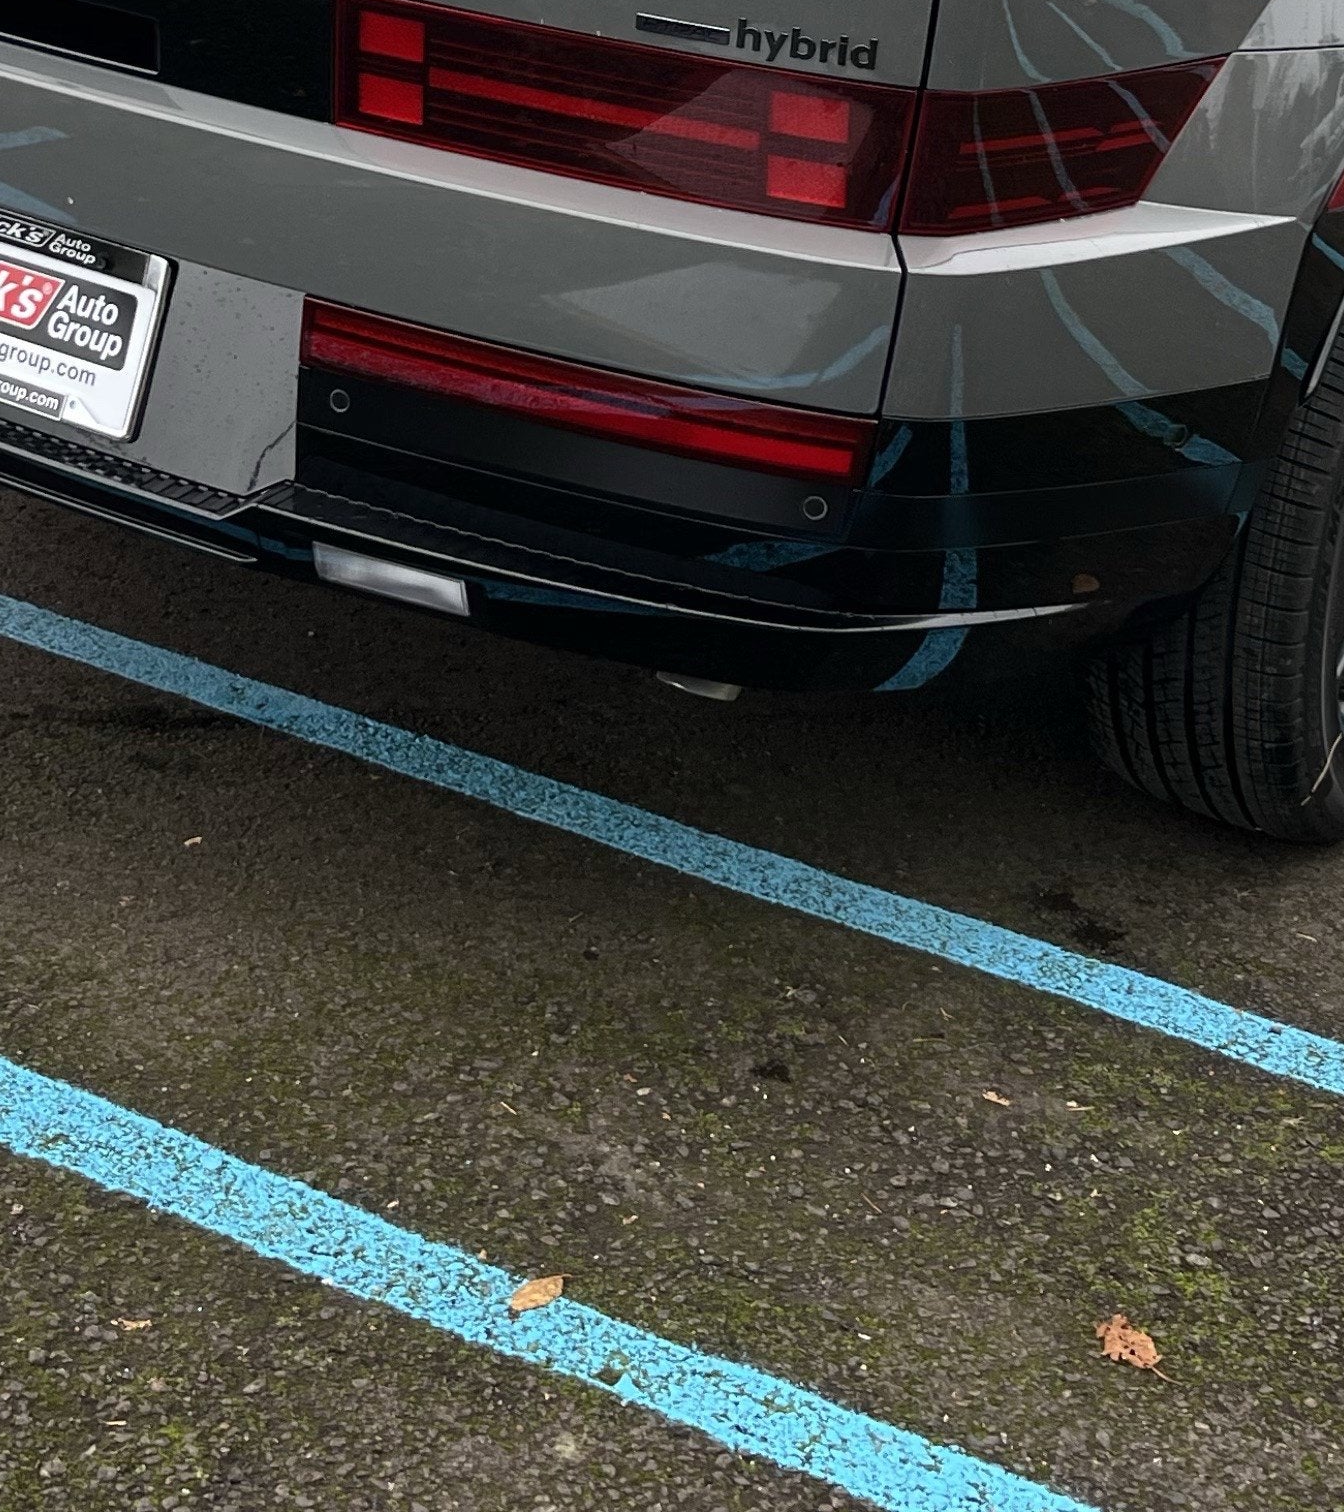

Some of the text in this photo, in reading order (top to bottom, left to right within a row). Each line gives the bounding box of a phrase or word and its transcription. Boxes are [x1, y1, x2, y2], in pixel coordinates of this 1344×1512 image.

[736, 16, 879, 70] hybrid
[49, 241, 96, 264] Group
[56, 233, 91, 252] Auto
[56, 284, 119, 326] Auto
[47, 310, 123, 360] Group
